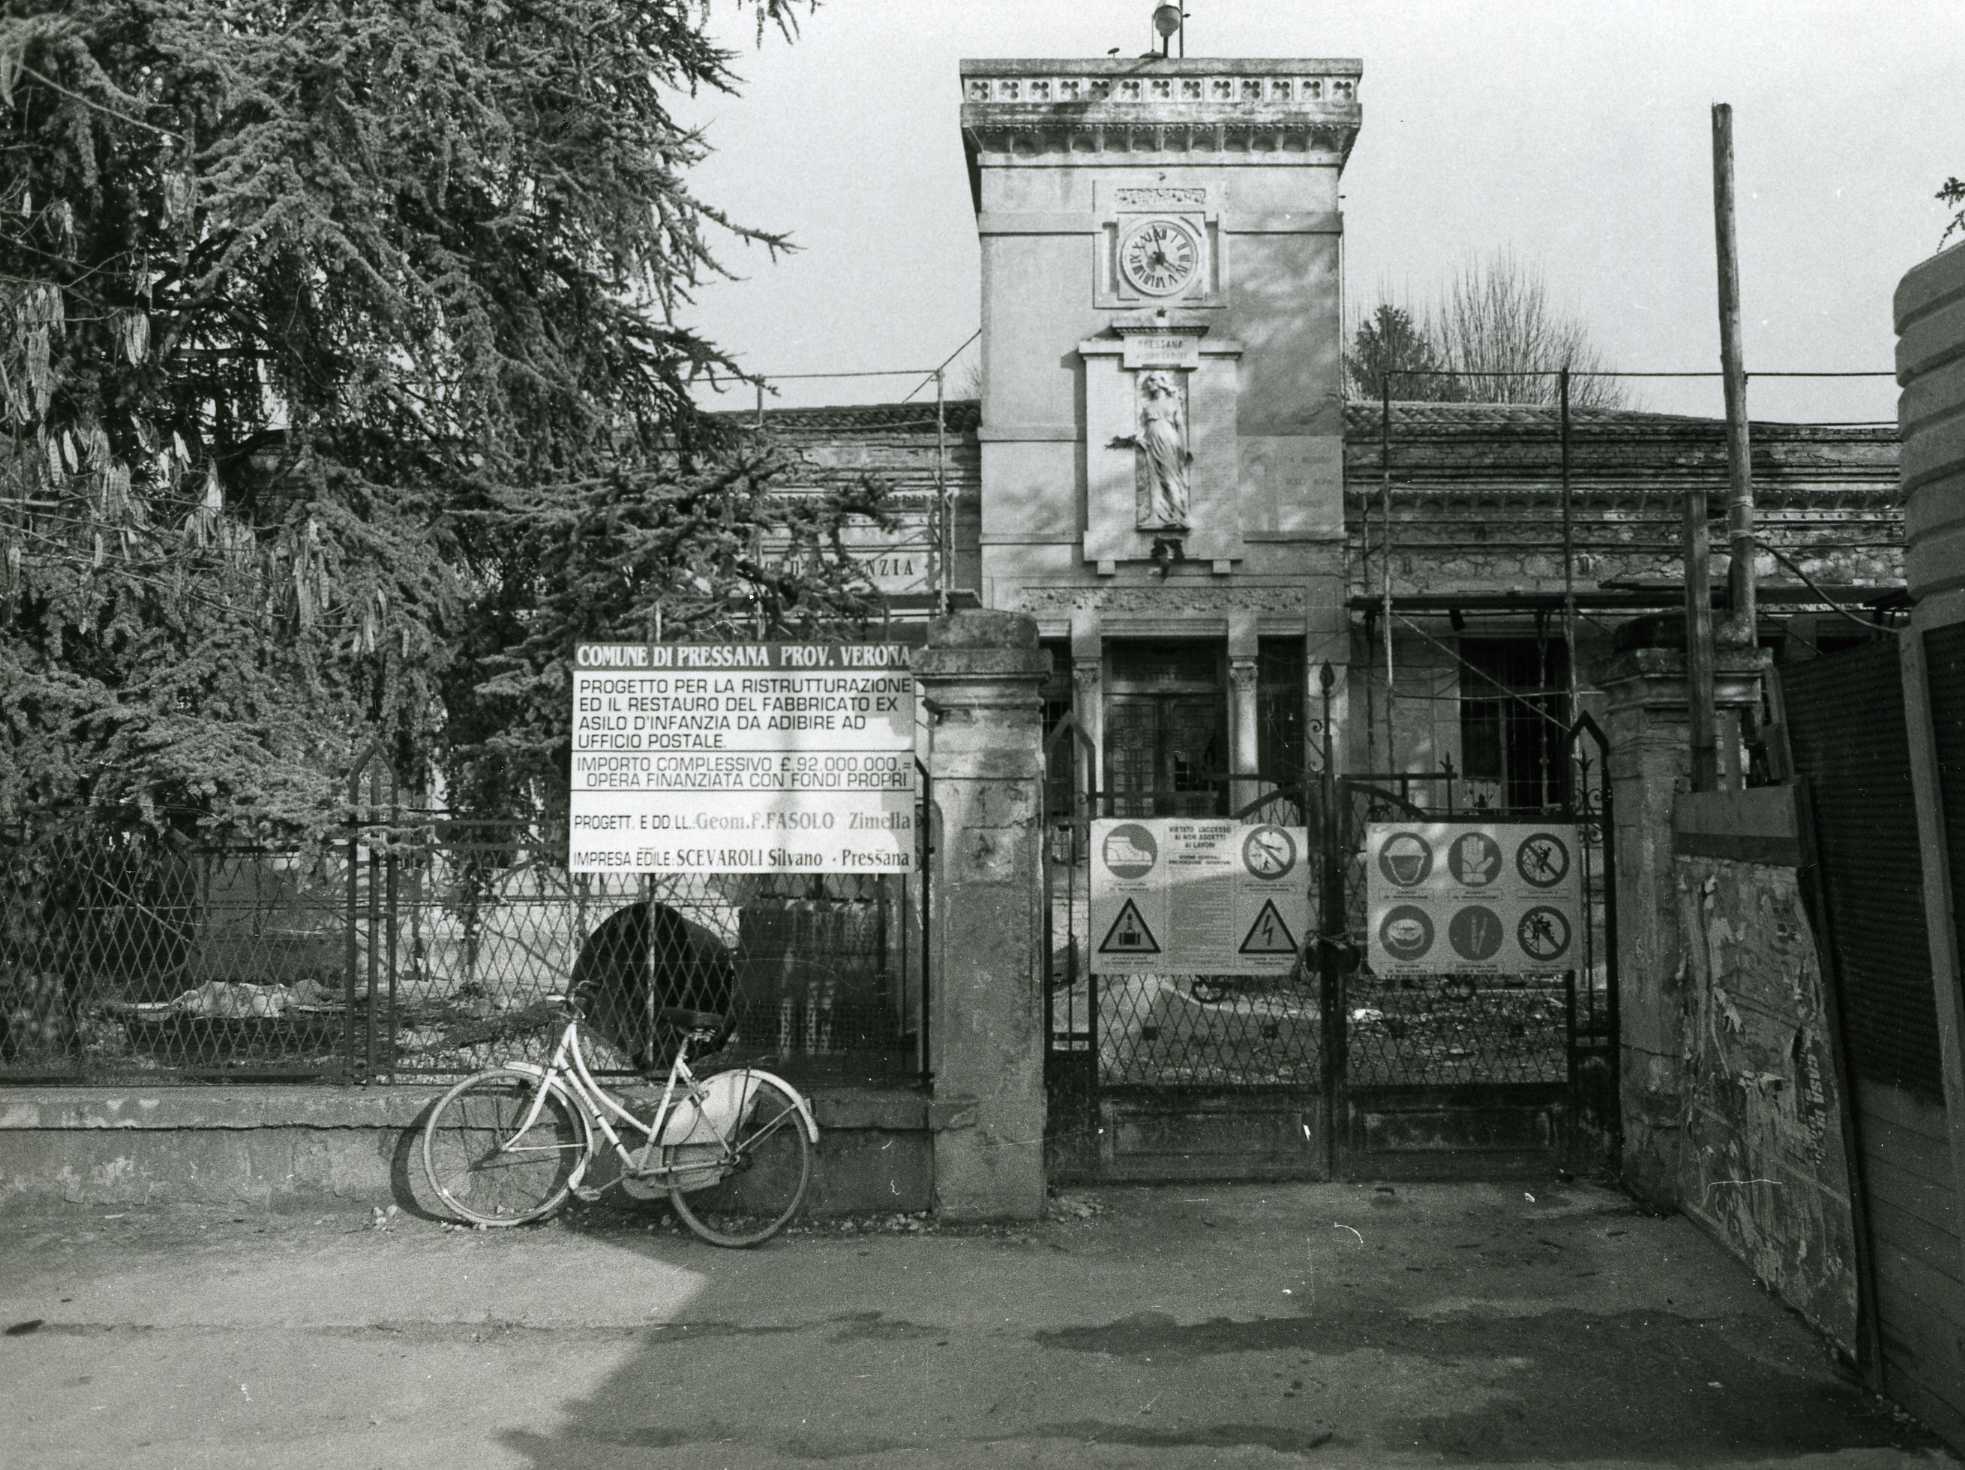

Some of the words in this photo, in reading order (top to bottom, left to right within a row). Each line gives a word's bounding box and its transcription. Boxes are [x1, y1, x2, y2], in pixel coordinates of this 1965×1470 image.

[577, 644, 649, 667] COMUNE
[653, 645, 673, 667] DI
[677, 645, 770, 667] PRESSANA
[780, 645, 834, 667] PROV.
[840, 645, 910, 667] VERONA
[580, 679, 668, 694] PROGETTO
[674, 679, 707, 694] PER
[714, 679, 734, 693] LA
[742, 678, 911, 693] RISTRUTTURAZIONE
[580, 697, 601, 712] ED
[608, 697, 621, 712] IL
[628, 697, 719, 712] RESTAURO
[725, 697, 757, 712] DEL
[763, 697, 870, 711] FABBRICATO
[876, 697, 898, 711] EX
[579, 716, 627, 730] ASILO
[634, 715, 730, 730] D'INFANZIA
[737, 716, 760, 730] DA
[768, 715, 835, 730] ADIBIRE
[842, 716, 866, 730] AD
[578, 734, 641, 748] UFFICIO
[577, 757, 650, 771] IMPORTO
[656, 757, 772, 771] COMPLESSIVO
[587, 773, 640, 787] OPERA
[647, 773, 743, 787] FINANZIATA
[750, 773, 784, 787] CON
[791, 773, 841, 787] FONDI
[847, 773, 907, 787] PROPRI
[640, 815, 647, 829] E
[850, 812, 911, 829] Zimella
[574, 851, 631, 866] IMPRESA
[677, 849, 762, 866] SCEVAROLI
[768, 848, 823, 866] Silvano
[842, 849, 910, 866] Pressana
